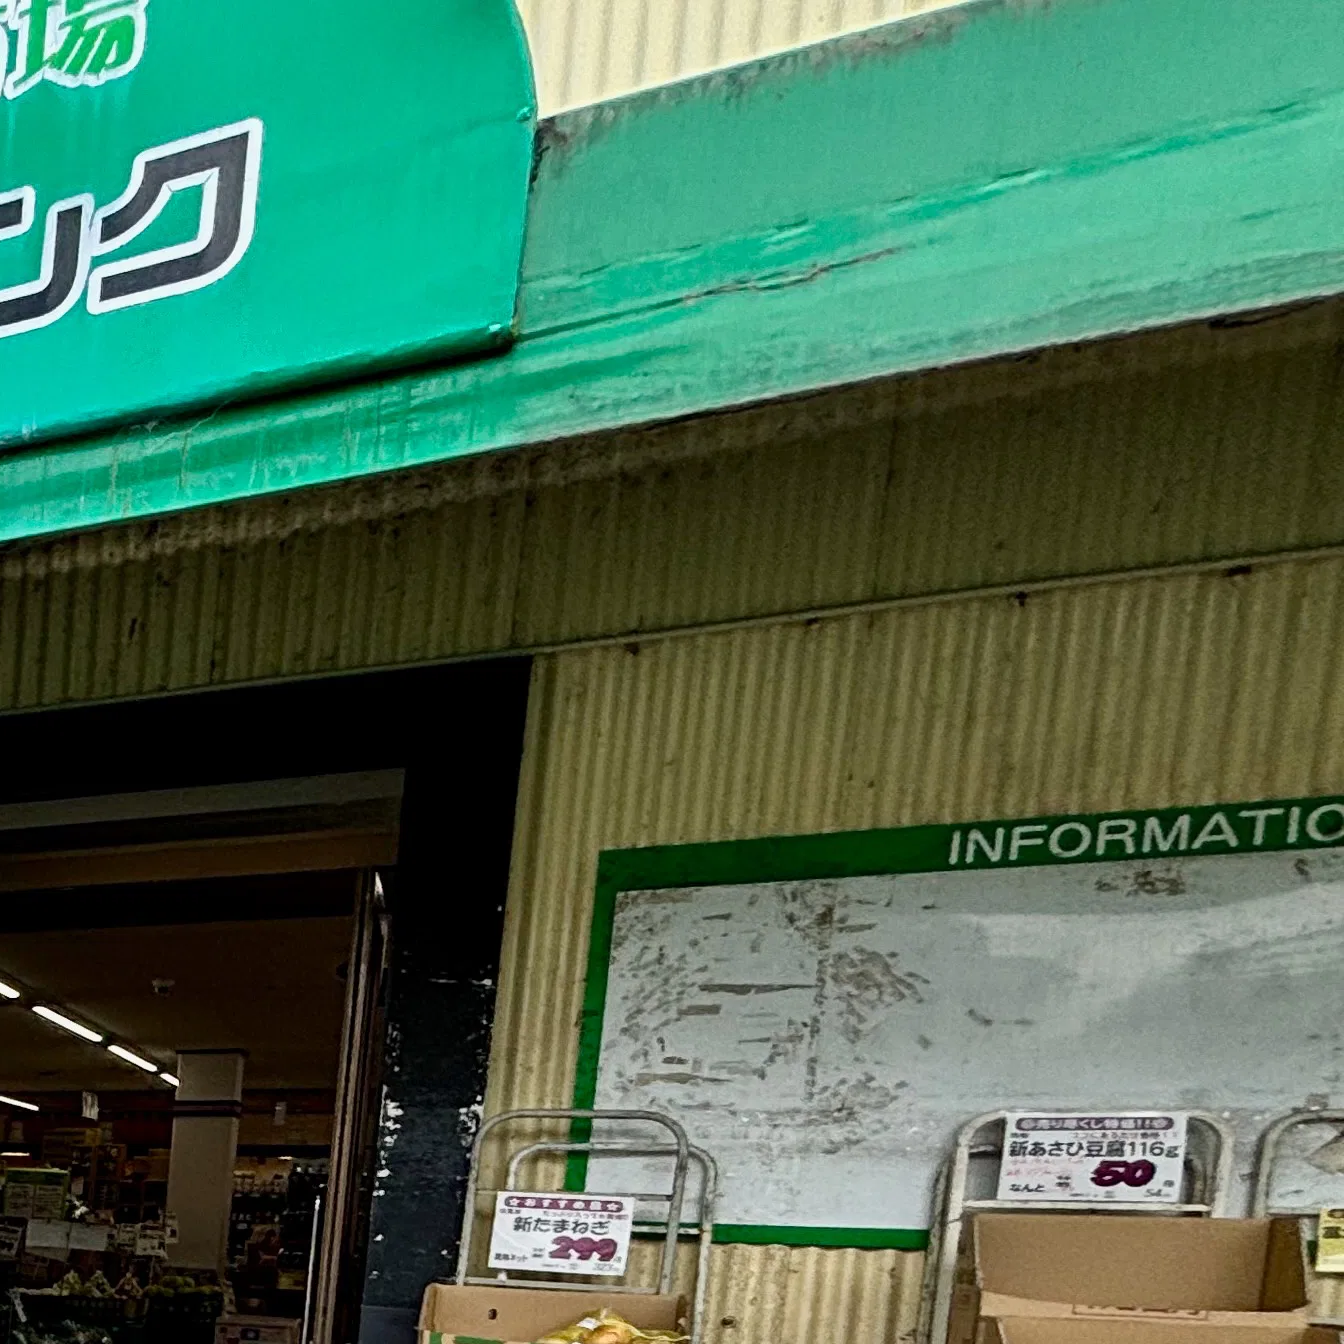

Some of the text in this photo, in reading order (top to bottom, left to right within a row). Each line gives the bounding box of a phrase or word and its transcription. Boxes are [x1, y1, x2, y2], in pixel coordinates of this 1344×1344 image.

[1090, 1159, 1156, 1187] 50
[512, 1216, 611, 1236] 新たまねぎ
[548, 1236, 618, 1262] 299
